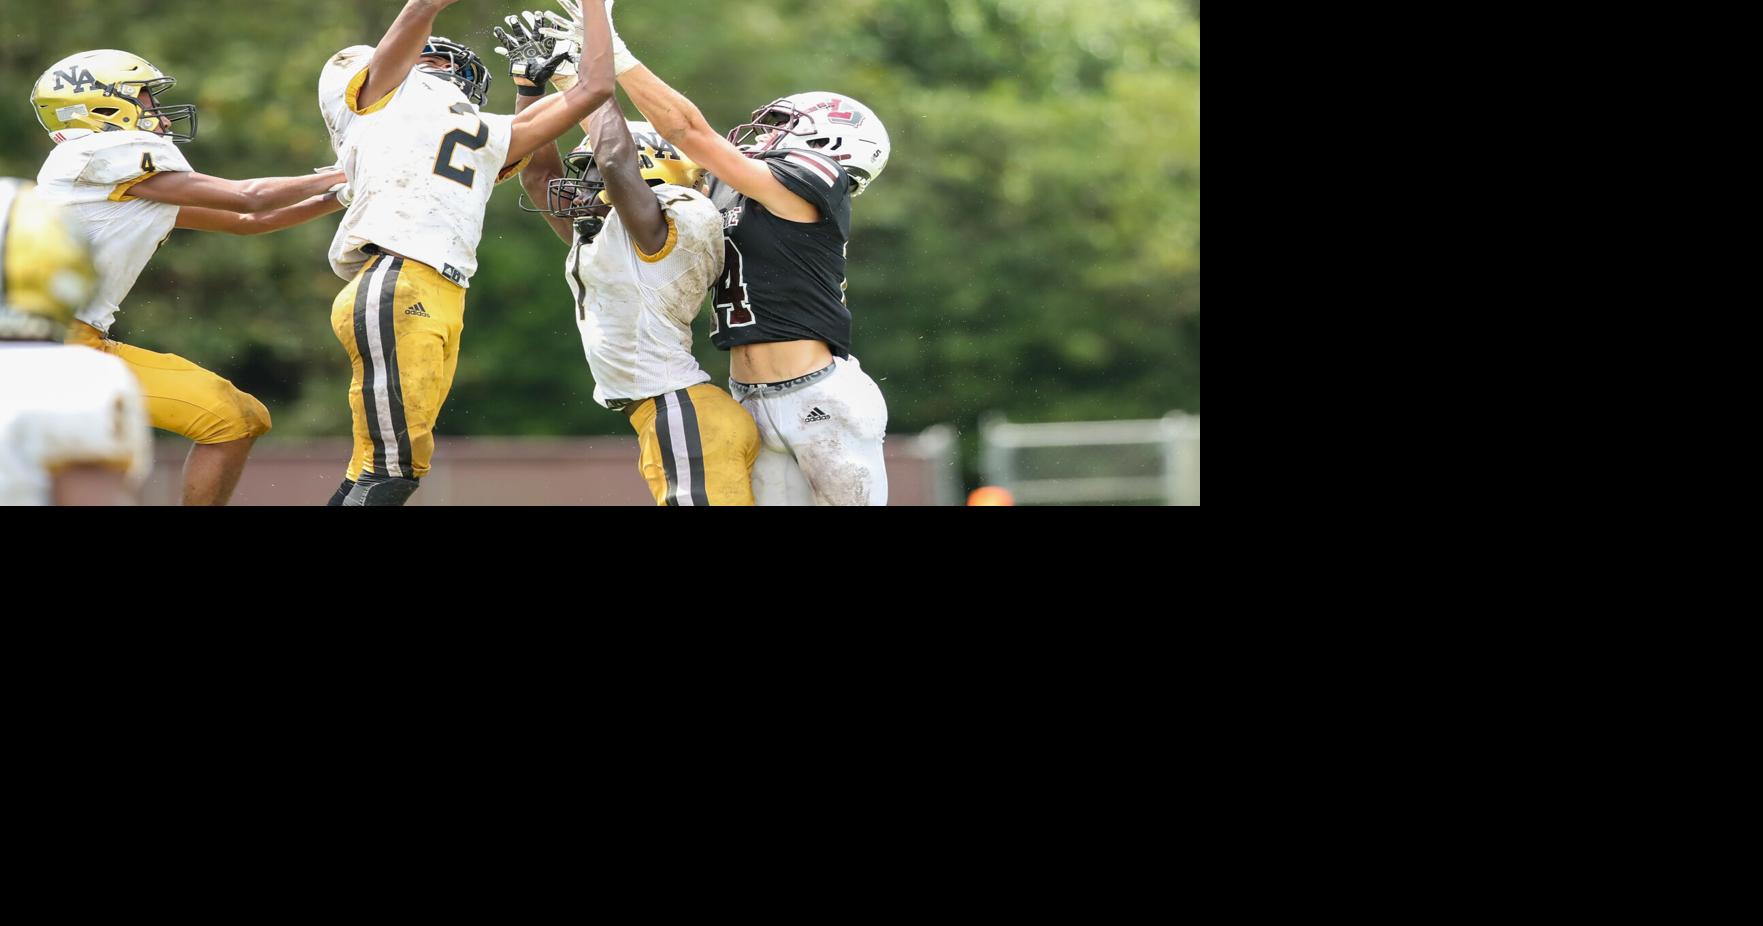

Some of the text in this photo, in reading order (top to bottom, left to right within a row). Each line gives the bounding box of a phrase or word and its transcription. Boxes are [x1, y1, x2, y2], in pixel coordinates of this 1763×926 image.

[53, 65, 98, 93] NA
[432, 101, 489, 190] 2
[140, 152, 156, 172] 4
[404, 309, 431, 319] adidas
[804, 414, 831, 423] adidas
